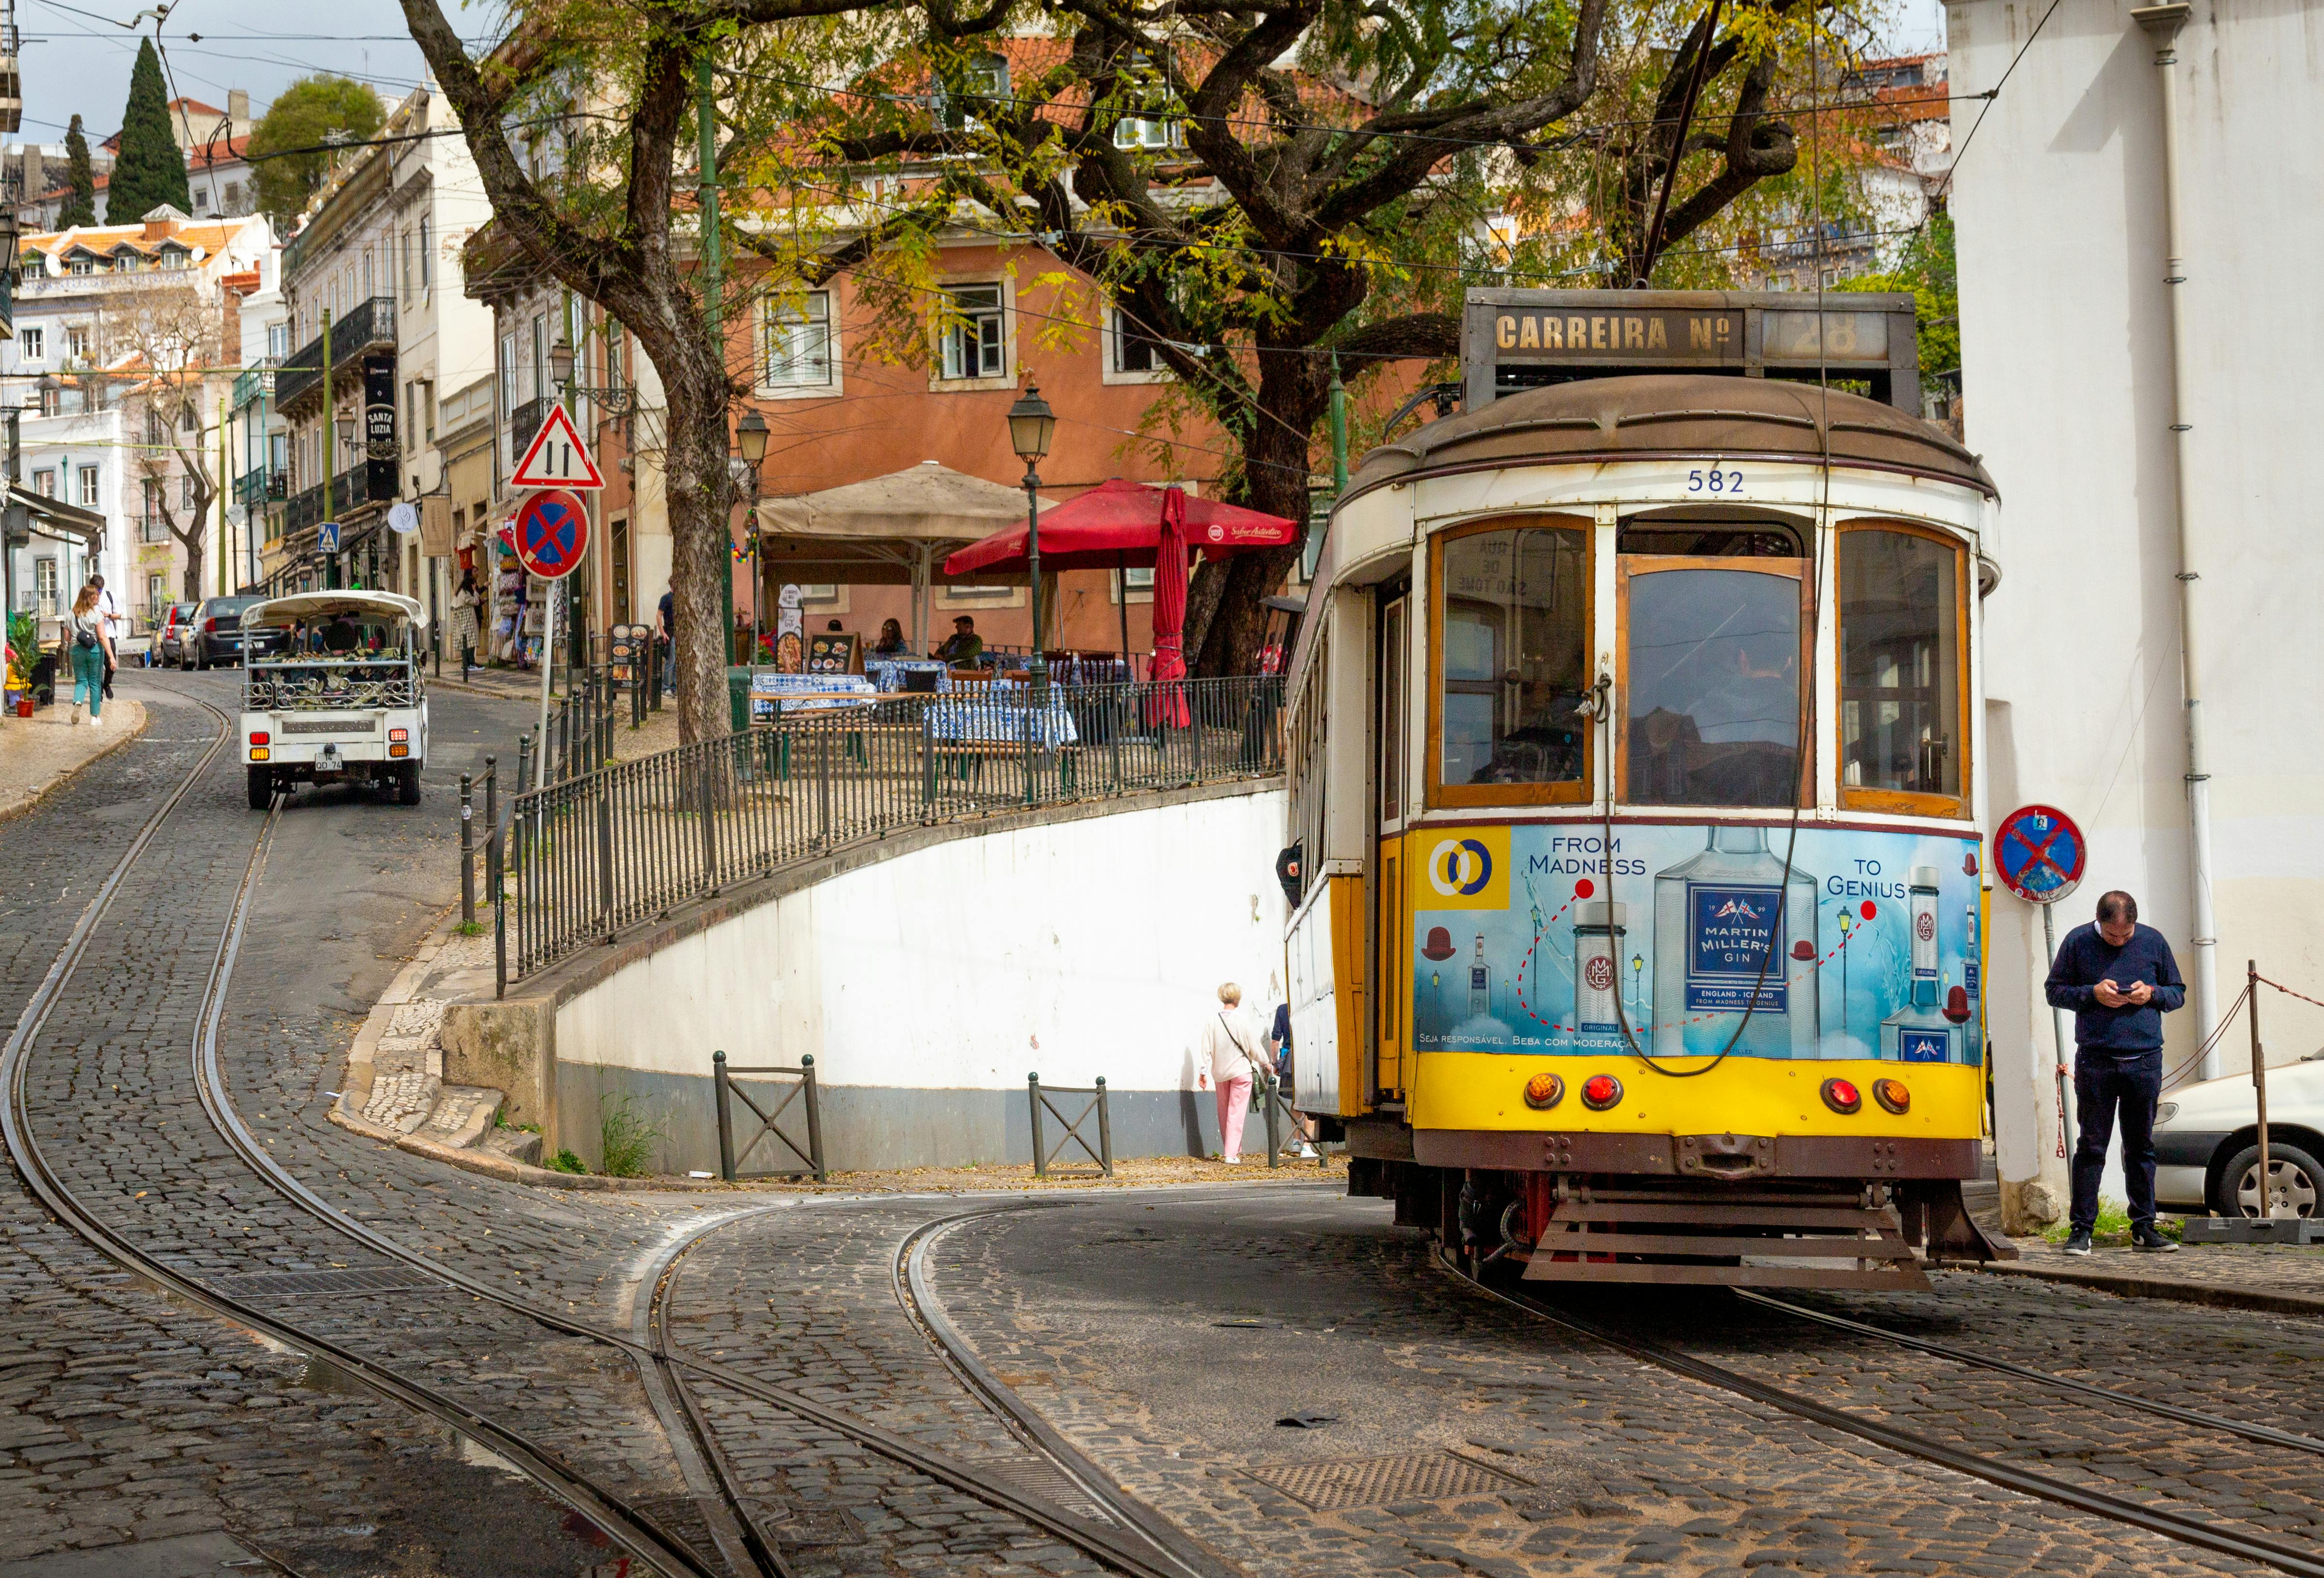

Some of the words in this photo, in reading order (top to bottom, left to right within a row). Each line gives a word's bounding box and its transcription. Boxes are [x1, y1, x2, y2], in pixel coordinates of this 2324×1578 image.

[1496, 315, 1666, 350] CARREIRA
[1790, 311, 1857, 354] 28
[368, 412, 393, 424] SANTA
[370, 424, 391, 434] LUZIA
[1688, 469, 1744, 493] 582
[1552, 837, 1621, 853] FROM
[1529, 855, 1646, 875] MADNESS
[1854, 859, 1881, 876] TO
[1827, 875, 1906, 899] GENIUS
[1705, 927, 1768, 937] MARTIN
[1701, 939, 1771, 953] MILLER'S
[1724, 953, 1750, 963] GIN
[1583, 1024, 1617, 1032] ORIGINAL
[1419, 1033, 1439, 1043] SEJA
[1512, 1035, 1541, 1046] BEBA
[1544, 1037, 1568, 1047] COM
